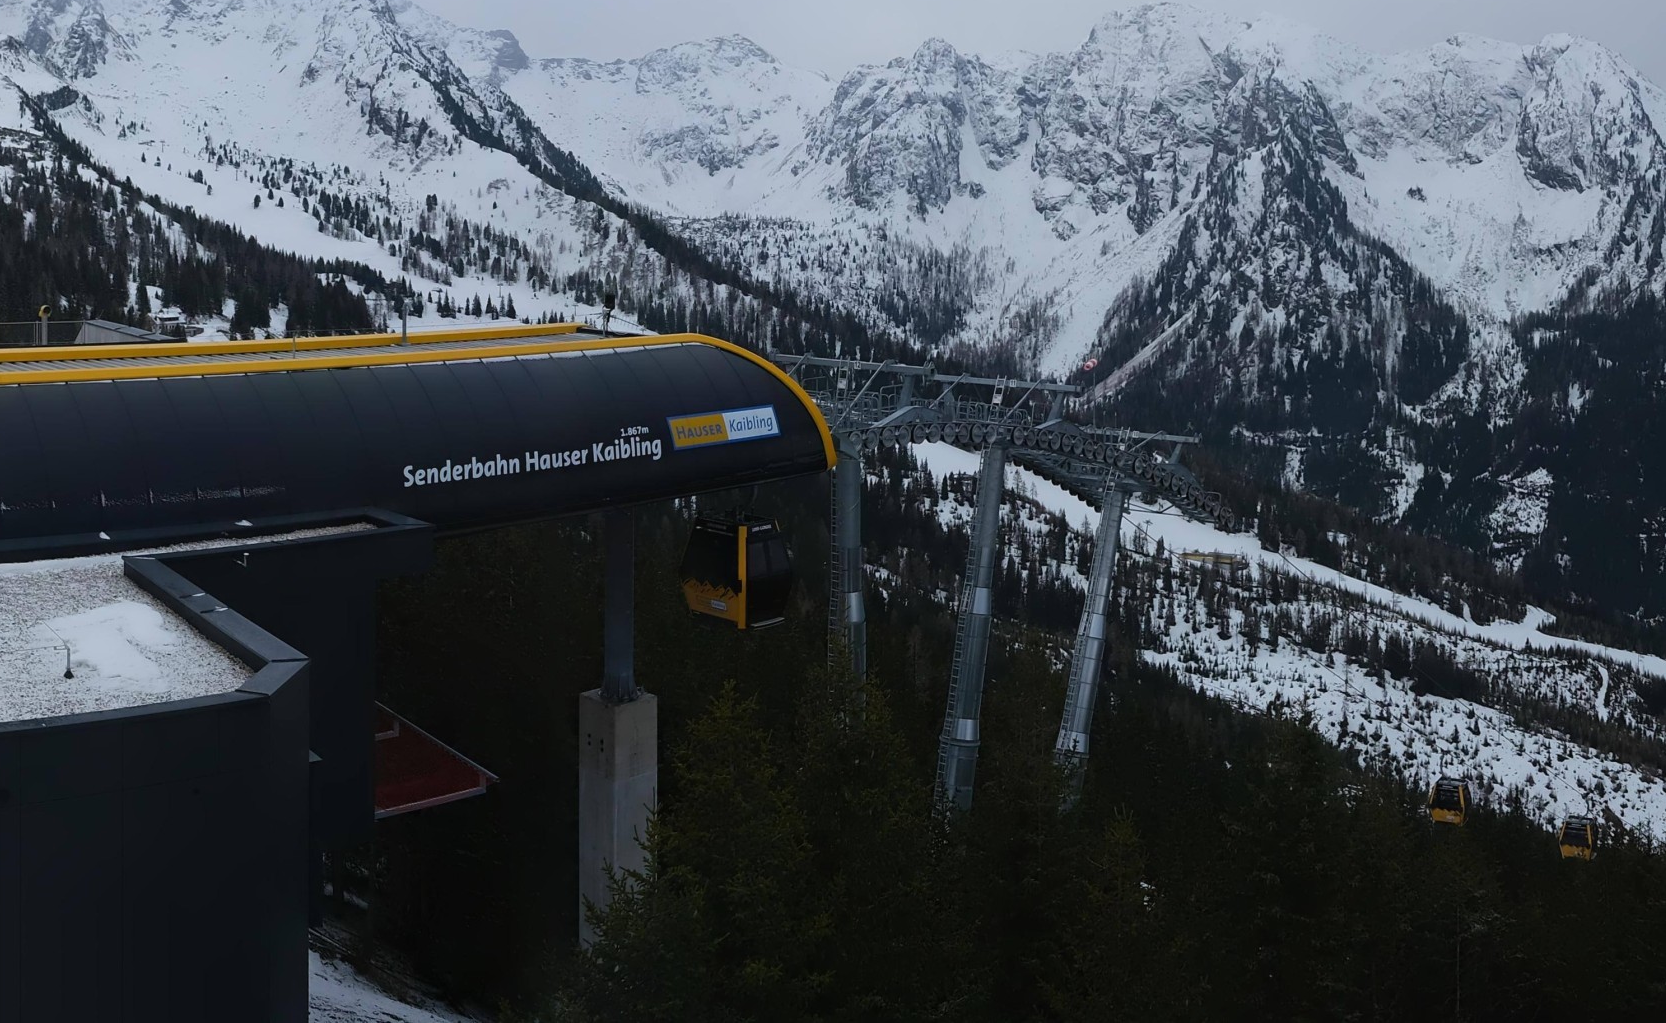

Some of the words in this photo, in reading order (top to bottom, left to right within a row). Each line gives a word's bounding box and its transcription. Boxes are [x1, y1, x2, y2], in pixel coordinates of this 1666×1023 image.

[620, 425, 649, 437] 1.867m
[676, 423, 723, 440] HAUSER
[728, 414, 774, 433] Kaibling
[403, 453, 520, 488] Senderbahn
[525, 448, 588, 472] Hauser
[592, 437, 662, 463] Kaibling
